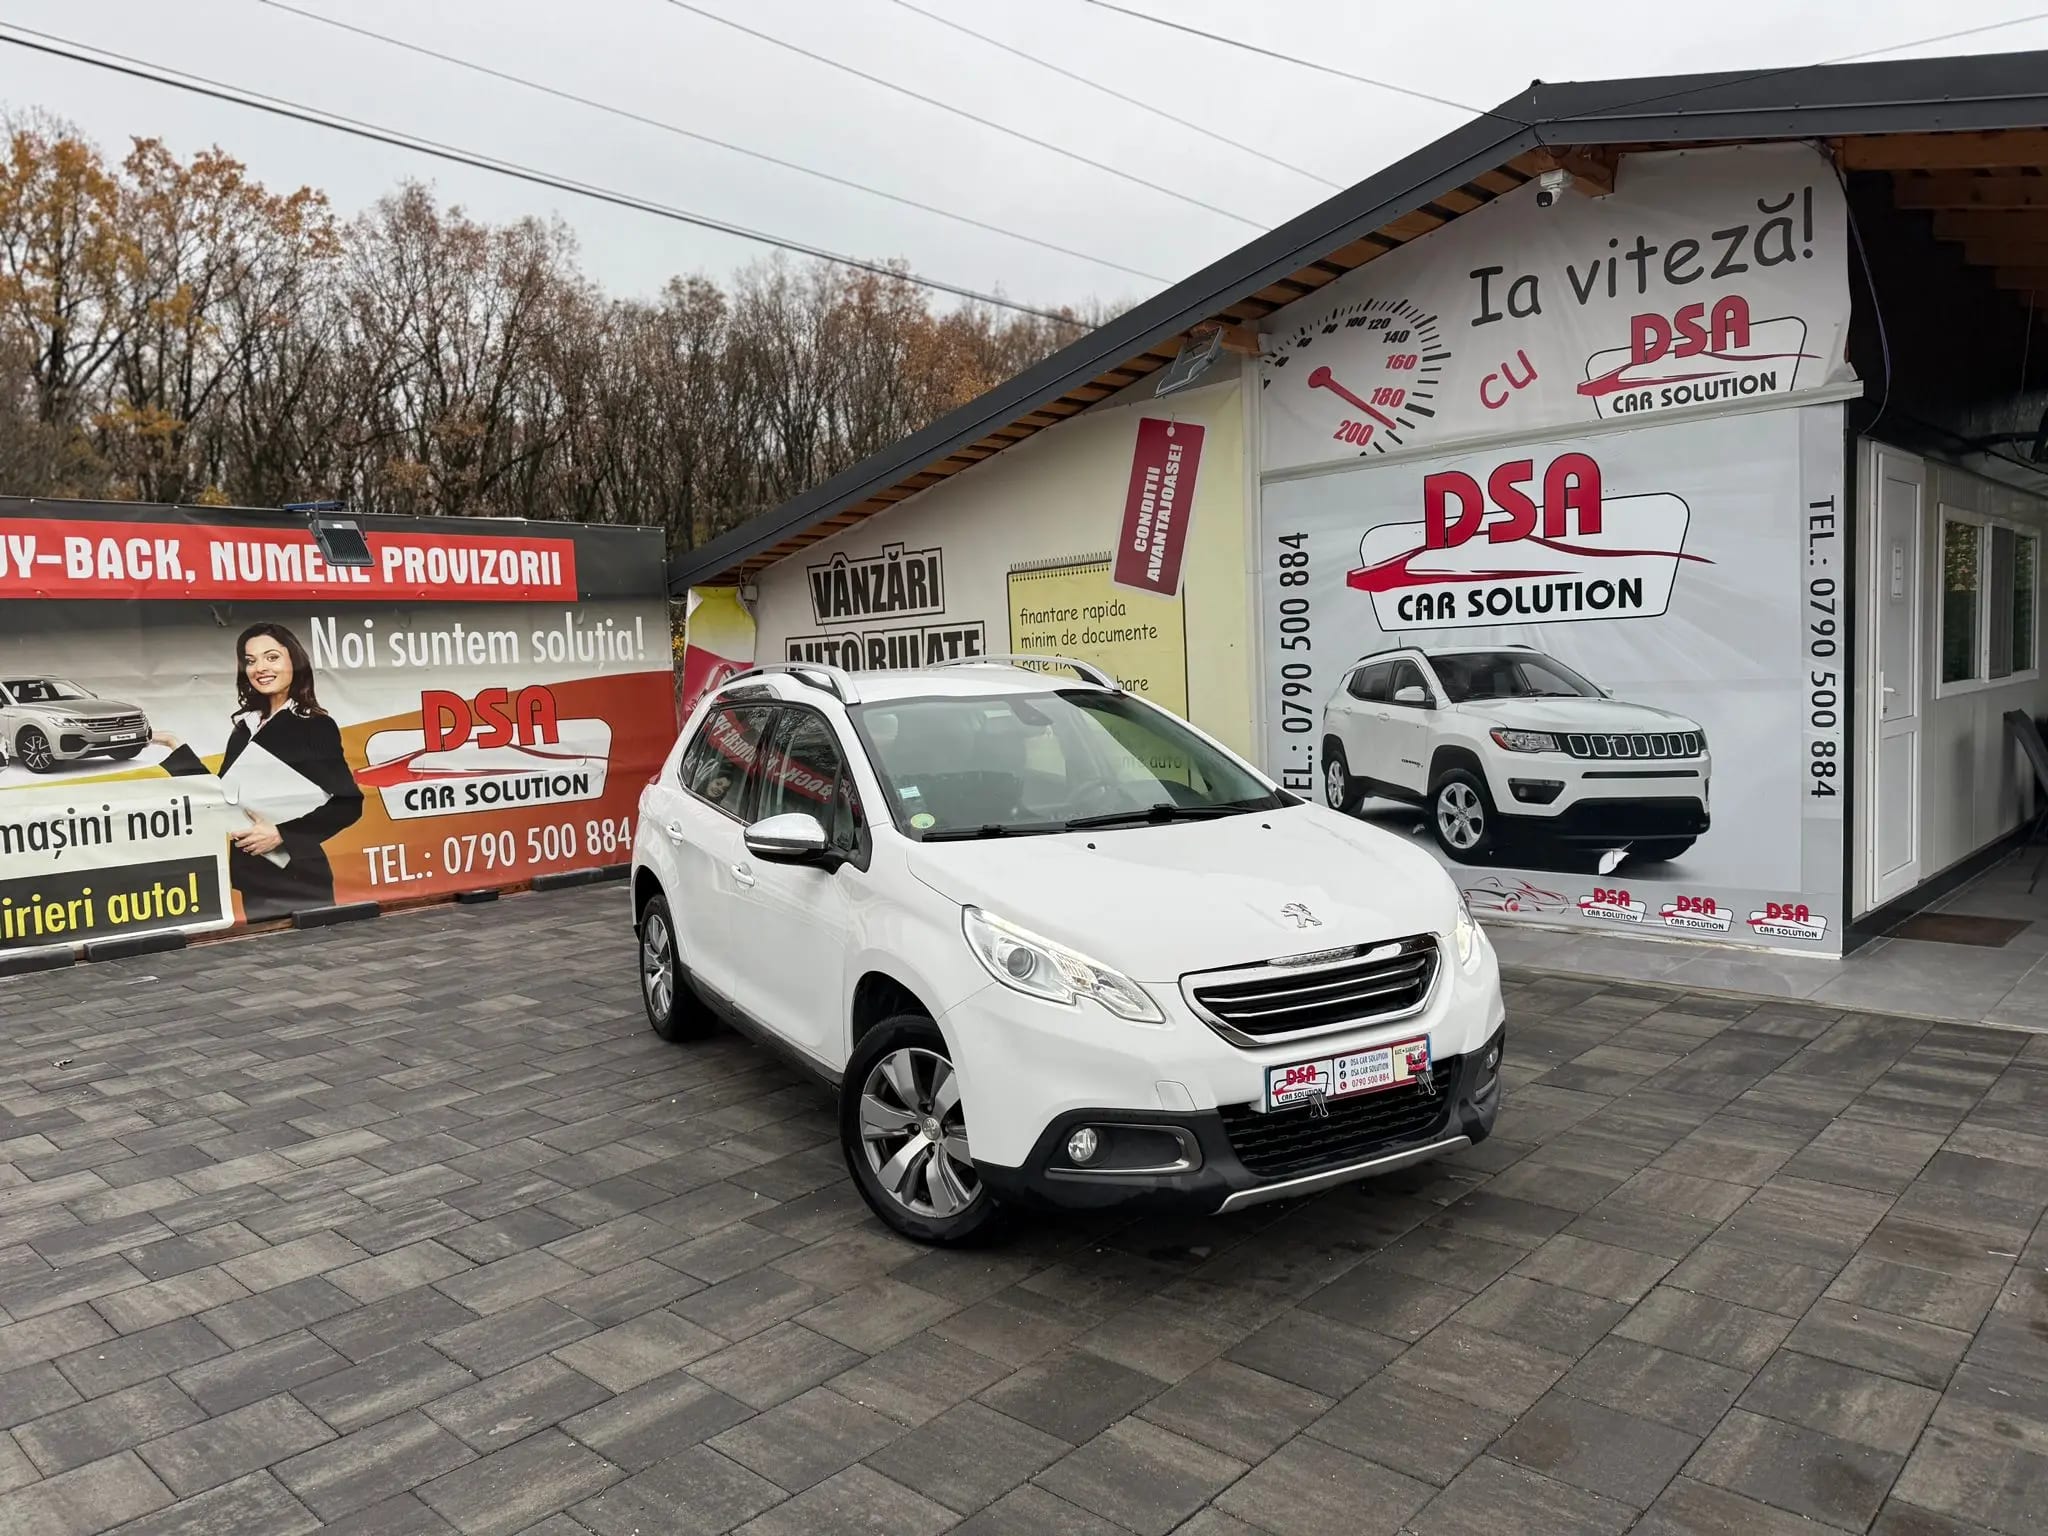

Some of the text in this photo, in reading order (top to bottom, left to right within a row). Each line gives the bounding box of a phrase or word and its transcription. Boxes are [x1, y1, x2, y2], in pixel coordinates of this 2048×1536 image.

[1470, 186, 1813, 327] Ia viteză!
[1367, 318, 1391, 330] 120
[1382, 329, 1410, 344] 140
[1631, 294, 1751, 366] DSA
[1384, 354, 1418, 370] 160
[1480, 349, 1538, 409] cu
[1370, 387, 1406, 408] 180
[1612, 371, 1777, 414] CAR SOLUTION
[1332, 420, 1375, 447] 200
[1134, 466, 1161, 553] CONDITII
[1146, 443, 1183, 583] AVANTAJOASE!
[1424, 452, 1602, 549] DSA
[381, 547, 562, 586] PROVIZORII
[812, 550, 940, 618] VÂNZĂRI
[1020, 599, 1127, 626] finantare rapida
[1398, 577, 1643, 622] CAR SOLUTION
[310, 611, 645, 671] Noi suntem soluția!
[1021, 624, 1158, 649] minim de documente
[1809, 494, 1837, 798] TEL.: 0790 500 884
[1278, 532, 1313, 802] EL.: 0790 500 884
[420, 685, 560, 753] DSA
[404, 773, 590, 812] CAR SOLUTION
[128, 796, 193, 842] noi!
[362, 816, 632, 887] TEL.: 0790 500 884
[0, 872, 200, 940] irieri auto!
[1587, 909, 1639, 921] CAR SOLUTION
[1593, 888, 1630, 907] DSA
[1676, 895, 1717, 915] DSA
[1766, 902, 1809, 922] DSA
[1670, 918, 1725, 930] CAR SOLUTION
[1759, 926, 1818, 938] CAR SOLUTION
[1285, 1064, 1317, 1085] DSA
[1351, 1077, 1366, 1088] 0790
